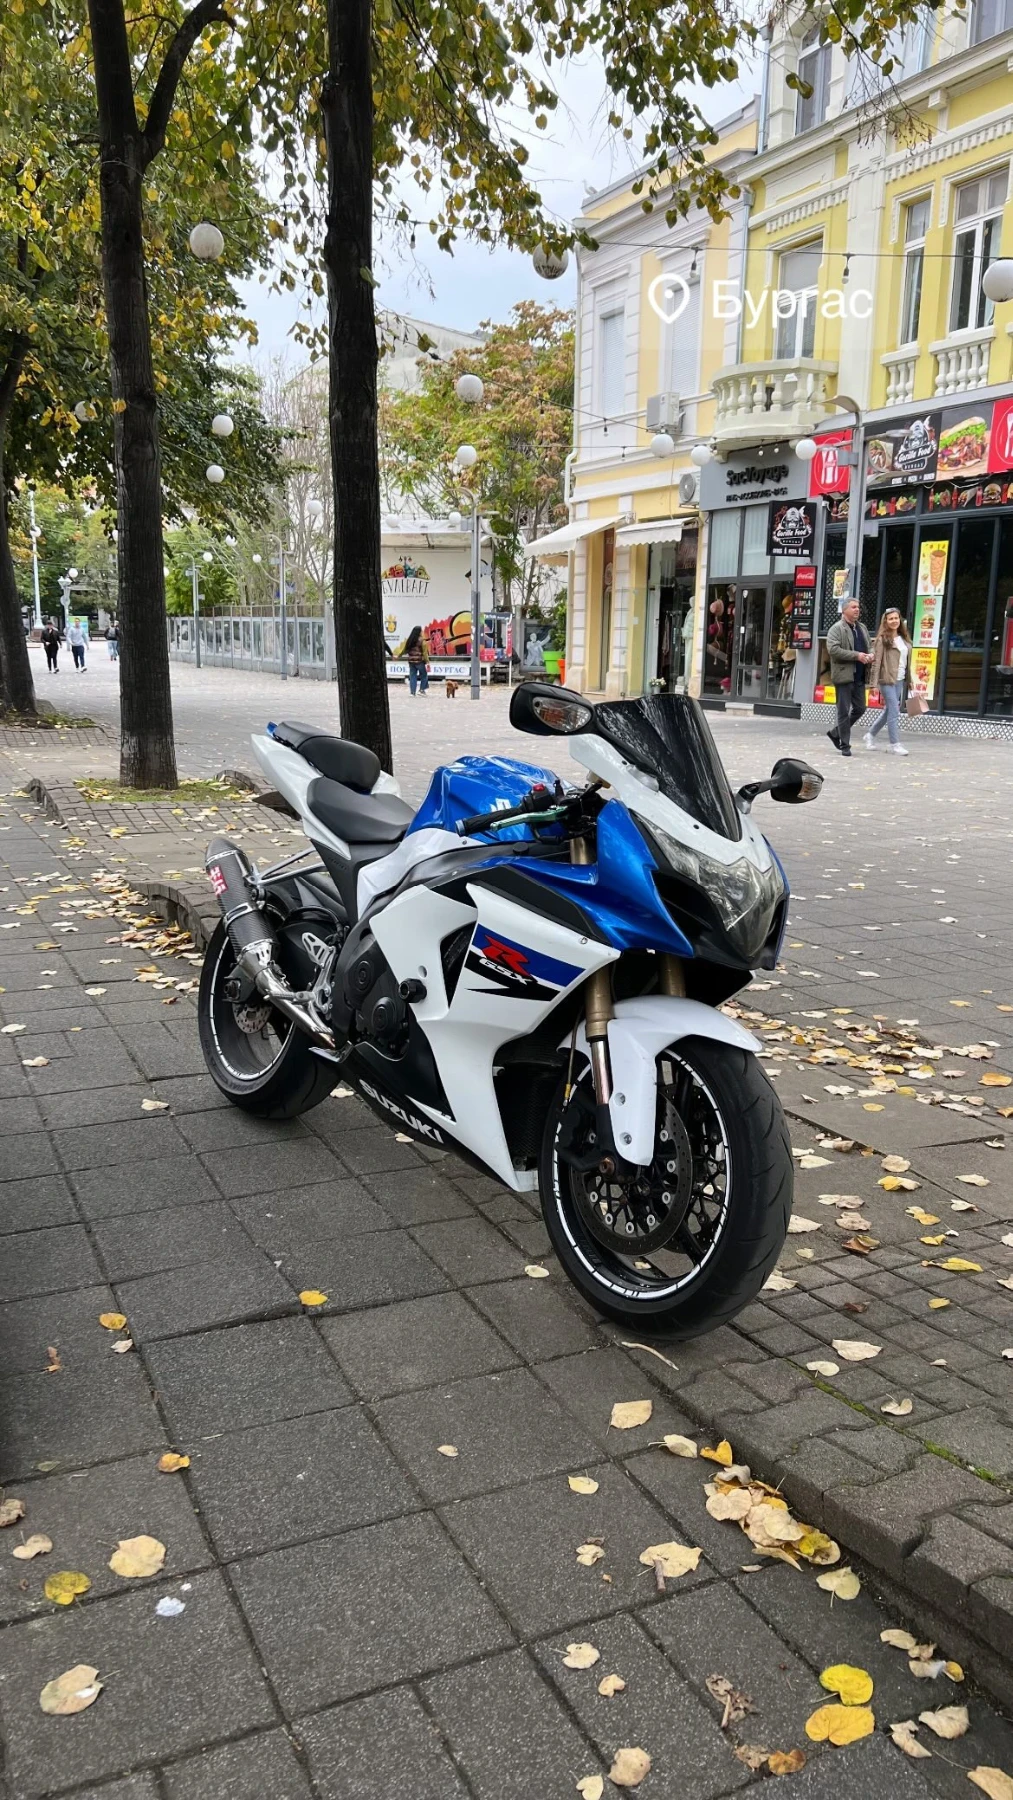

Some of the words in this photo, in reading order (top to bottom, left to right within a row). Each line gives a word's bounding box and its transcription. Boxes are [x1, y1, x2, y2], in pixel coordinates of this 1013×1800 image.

[898, 450, 917, 463] Gorilla
[917, 444, 932, 457] Food
[776, 529, 794, 537] Gorilla
[794, 528, 807, 536] Food
[920, 631, 933, 639] NEW
[433, 666, 466, 674] БУРГАС
[915, 683, 928, 691] NEW
[359, 1079, 445, 1144] SUZUKI
